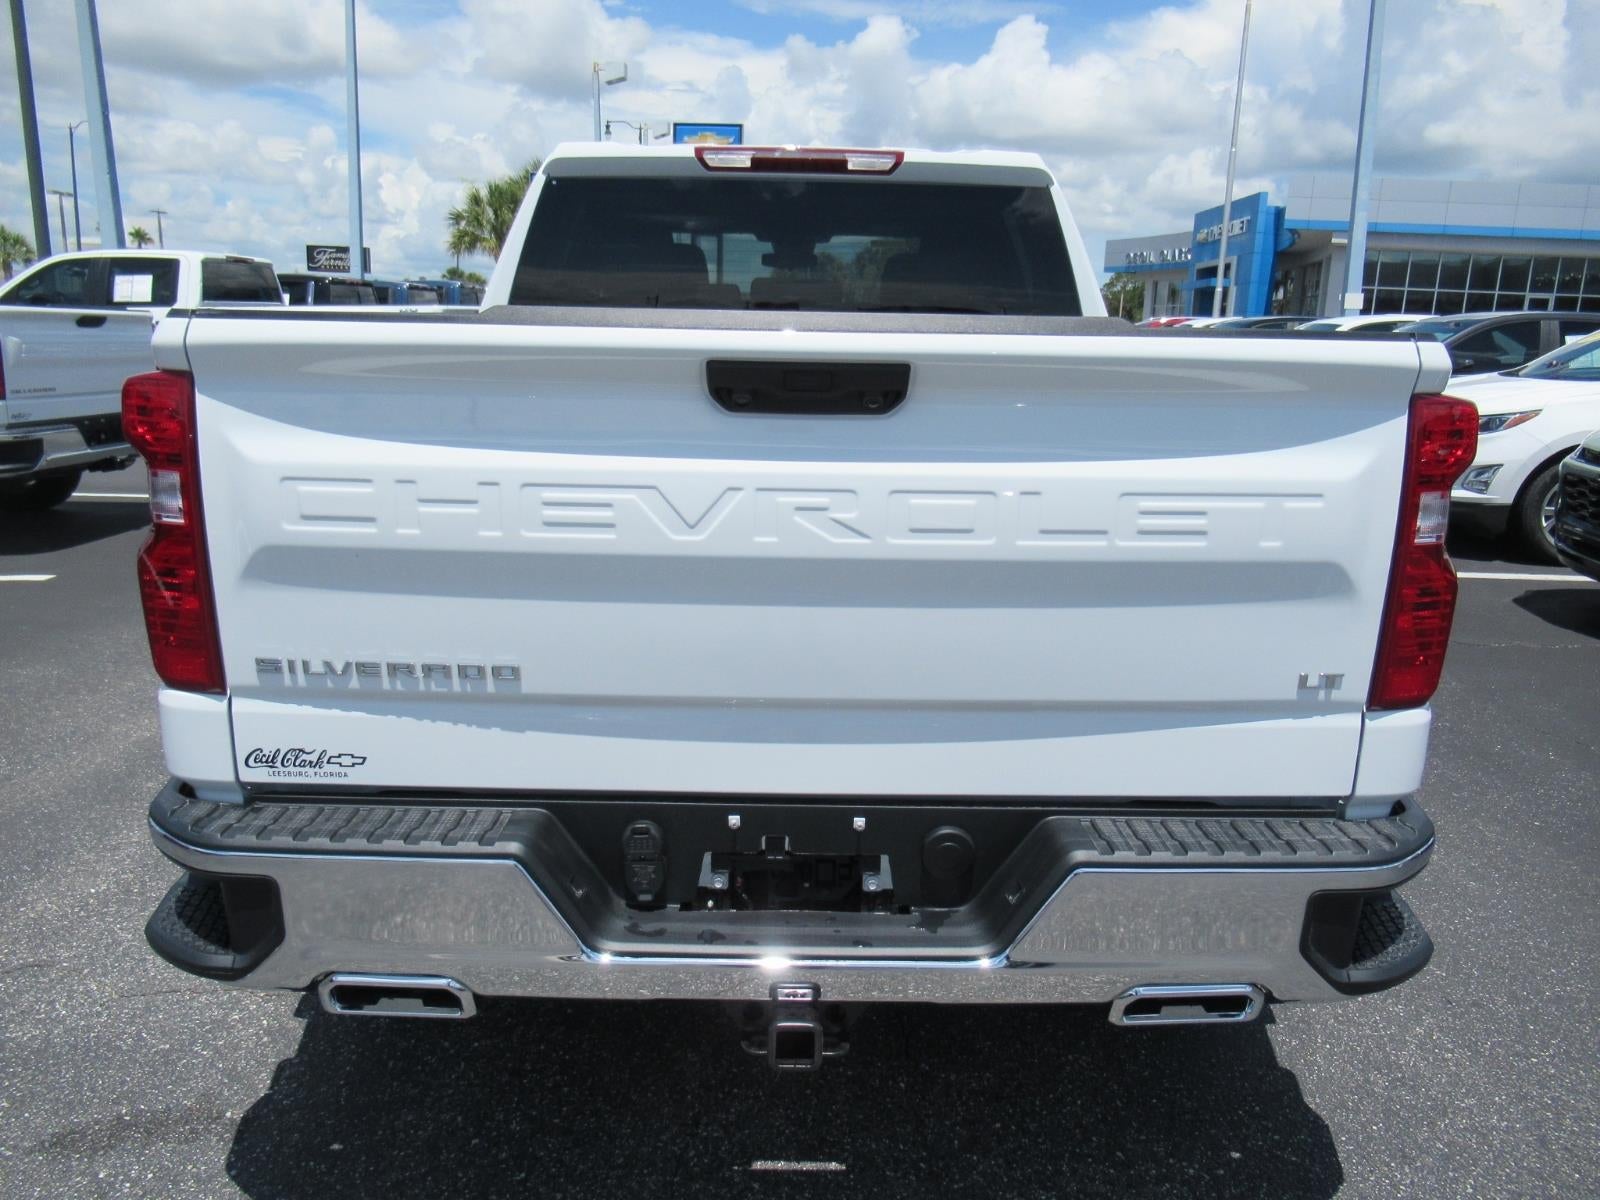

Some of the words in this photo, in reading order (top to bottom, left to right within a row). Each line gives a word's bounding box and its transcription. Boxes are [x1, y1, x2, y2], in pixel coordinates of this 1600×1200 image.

[279, 477, 1325, 548] CHEVROLET
[255, 657, 521, 681] SILVERADO
[1298, 672, 1345, 690] LT
[244, 747, 281, 769] Cecil
[280, 747, 328, 769] Clark
[267, 770, 312, 779] LEESBURG,
